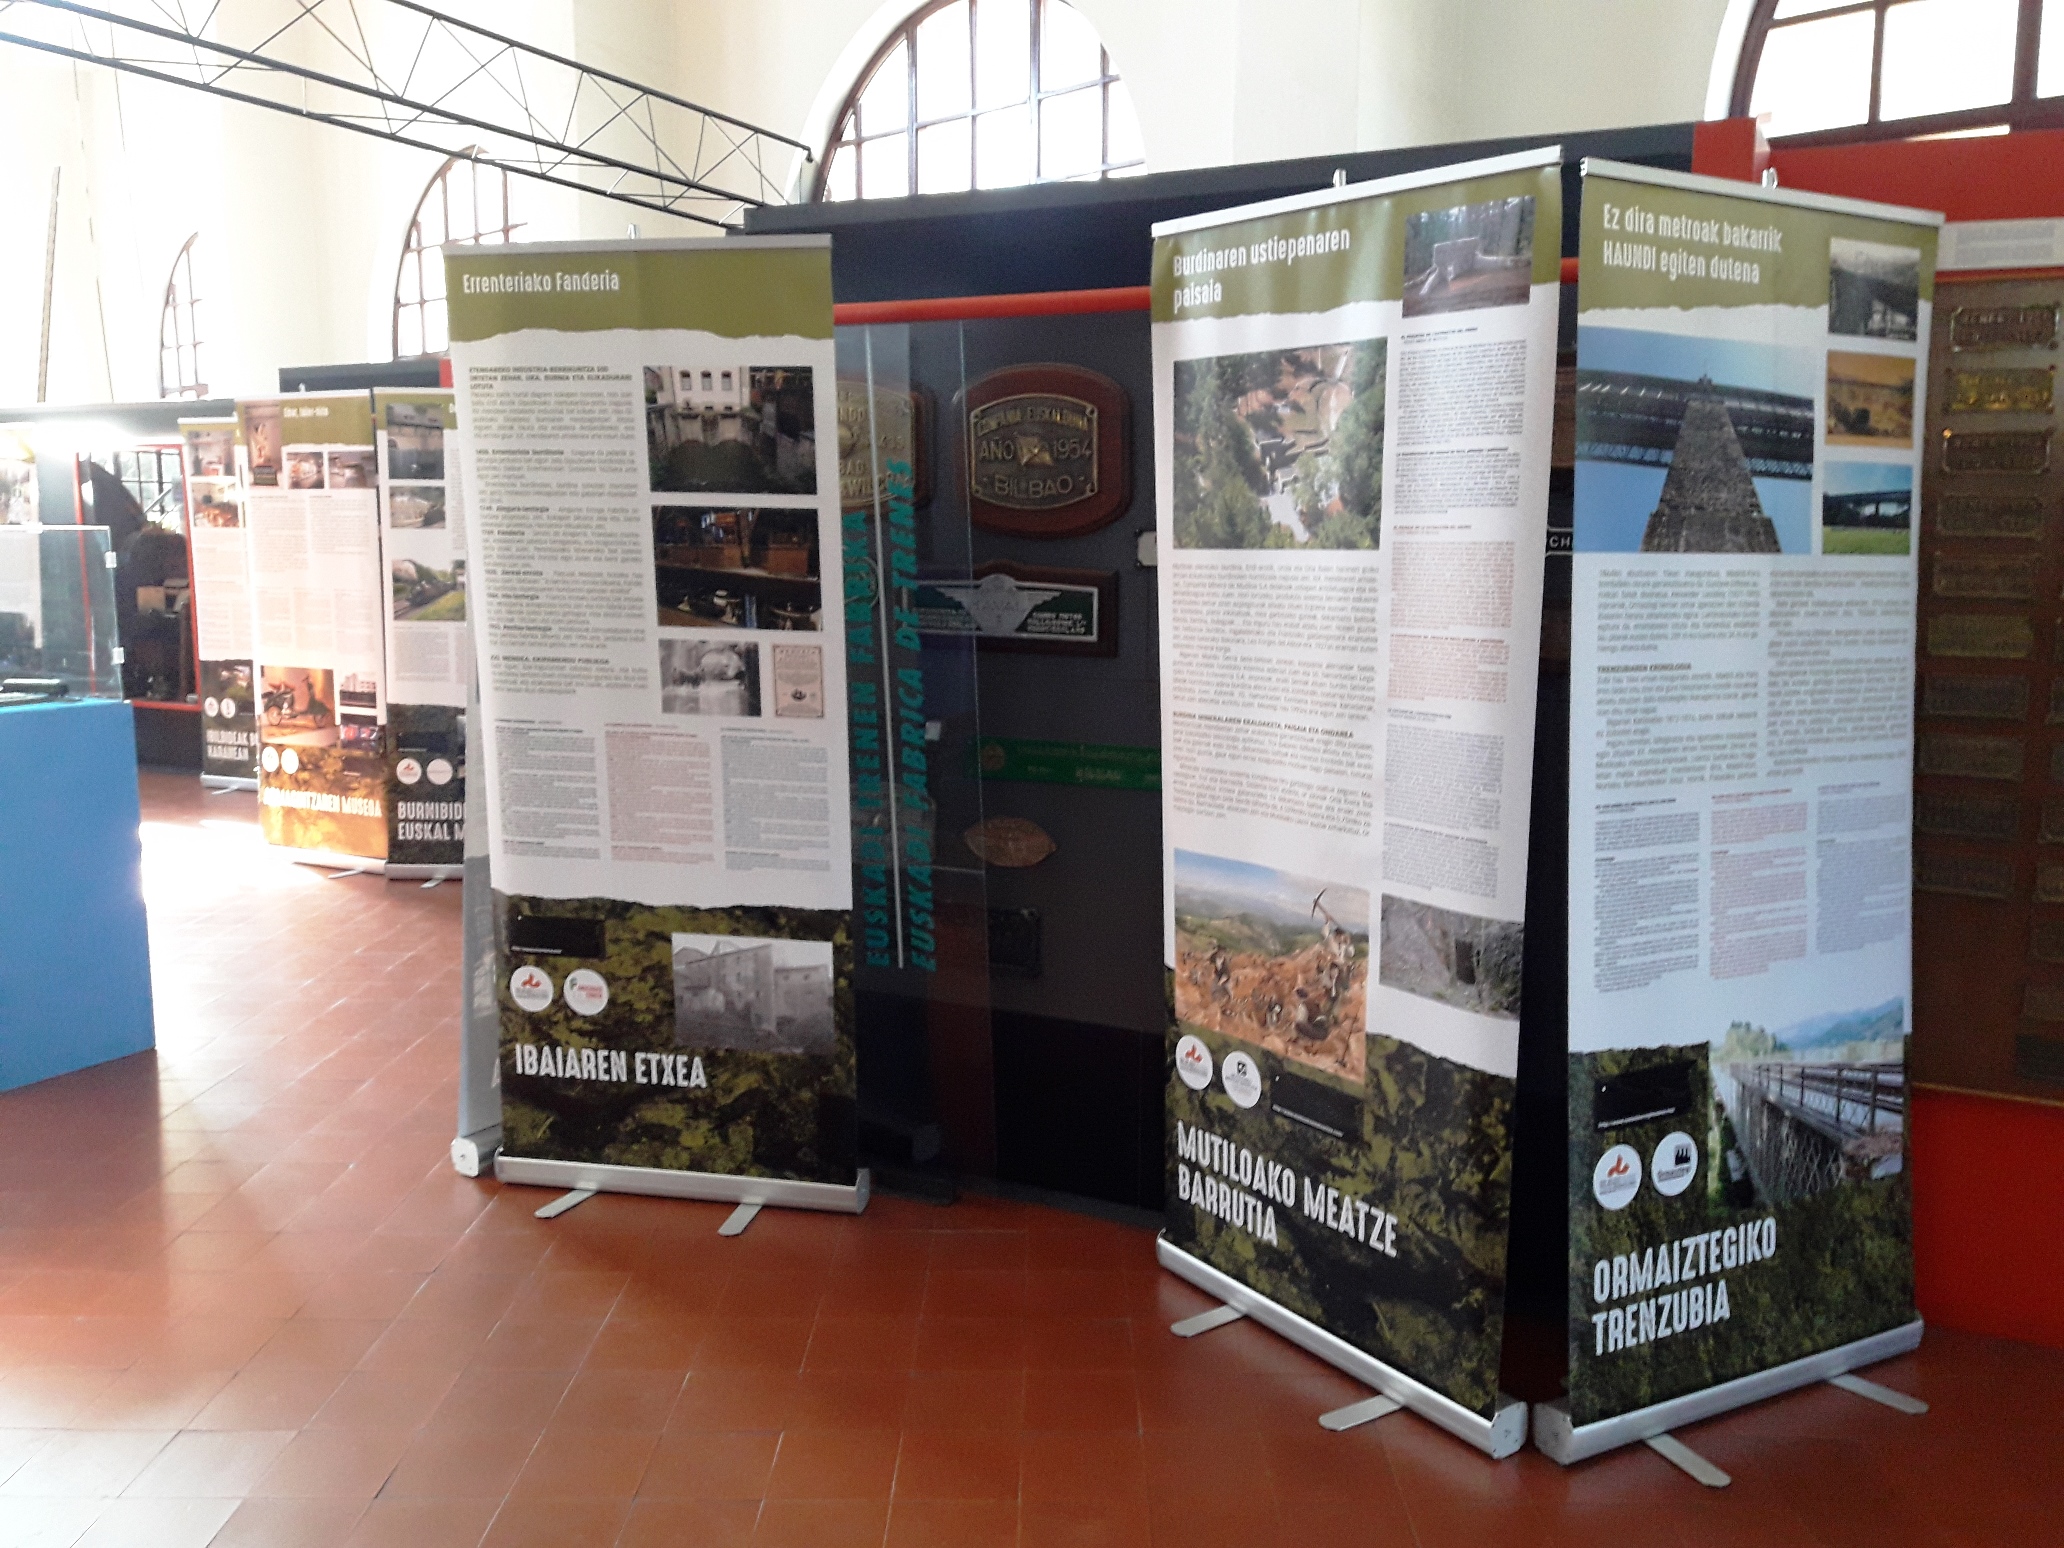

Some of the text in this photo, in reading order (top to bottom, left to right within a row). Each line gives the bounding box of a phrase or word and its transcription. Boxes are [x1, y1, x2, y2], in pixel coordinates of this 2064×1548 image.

[1603, 203, 1783, 253] Ez dira metroak bakarrik
[1173, 228, 1350, 277] Burdinaren ustiepenaren
[1602, 239, 1760, 285] HAUNDI egiten dutena
[462, 269, 620, 294] Errenteriako Fanderia
[1173, 279, 1222, 314] paisaia
[980, 436, 1093, 461] AÑO 1954
[995, 474, 1073, 499] BILBAO
[886, 457, 918, 590] TRENES
[893, 607, 922, 651] DE
[397, 801, 466, 821] BURNIBID
[397, 822, 450, 841] EUSKAL
[859, 827, 891, 967] EUSKADI
[905, 826, 937, 972] EUSKADI
[515, 1043, 708, 1089] IBAIAREN ETXEA
[1177, 1119, 1399, 1258] MUTILOAKO MEATZE
[1177, 1162, 1279, 1247] BARRUTIA
[1592, 1216, 1777, 1305] ORMAIZTEGIKO
[1591, 1278, 1731, 1357] TRENZUBIA
